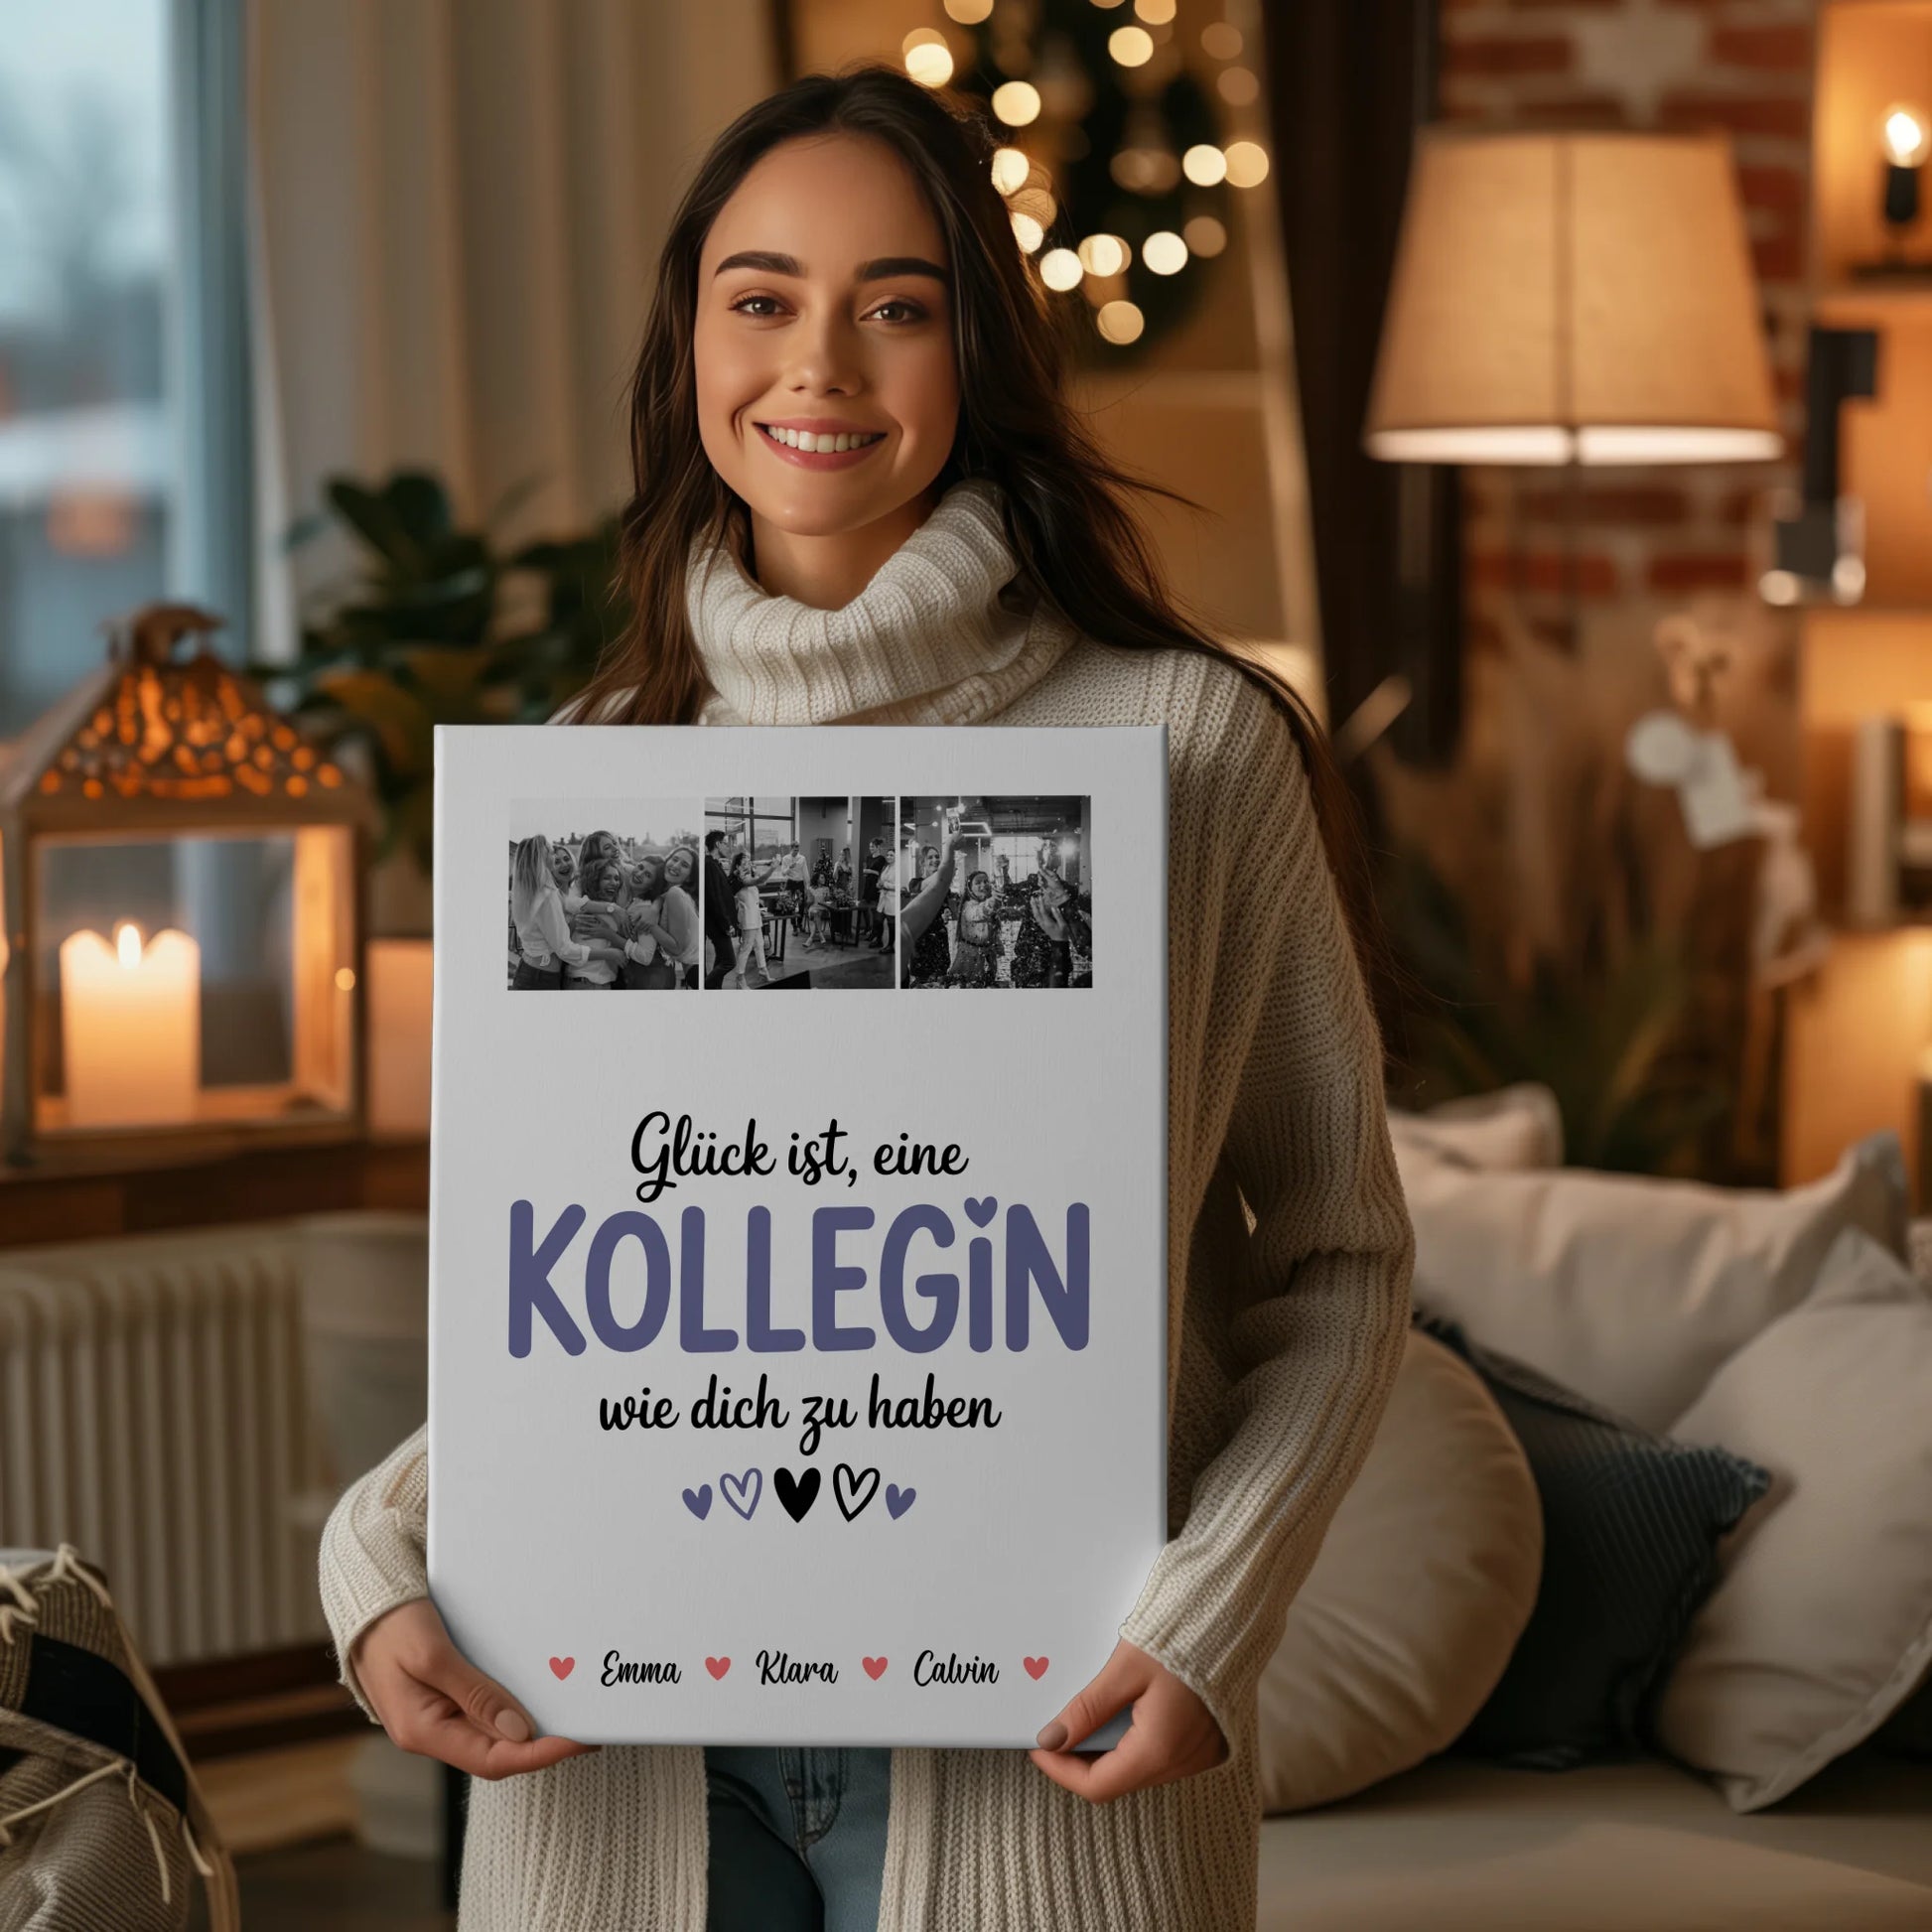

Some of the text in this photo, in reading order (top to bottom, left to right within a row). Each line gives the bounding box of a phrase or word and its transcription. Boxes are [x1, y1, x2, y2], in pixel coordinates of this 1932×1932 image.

[630, 1111, 970, 1203] Glück ist, eine
[599, 1372, 1003, 1456] wie dich zu haben
[600, 1649, 1001, 1688] Emma Klara Calvin
